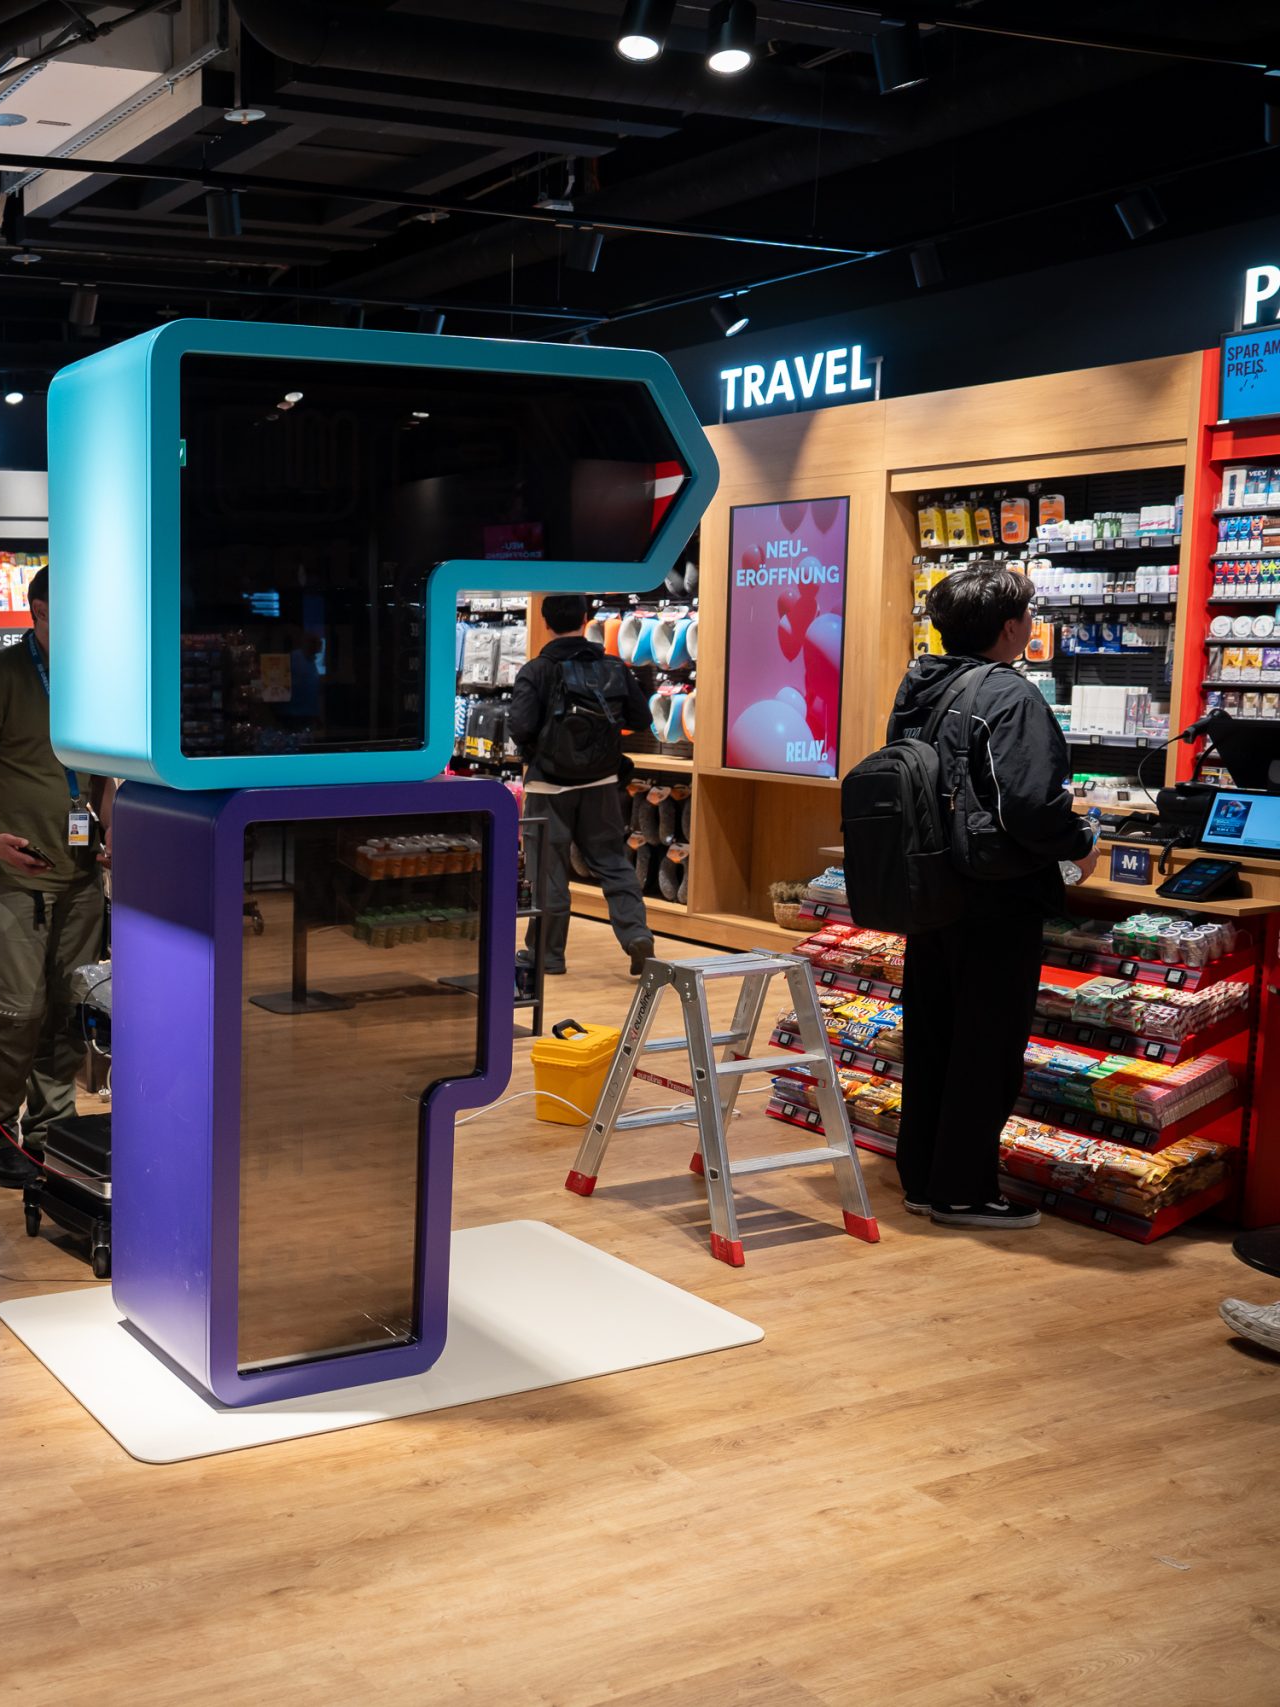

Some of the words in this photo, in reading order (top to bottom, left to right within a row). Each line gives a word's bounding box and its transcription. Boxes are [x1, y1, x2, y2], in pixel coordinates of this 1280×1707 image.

[1243, 264, 1280, 326] P
[1227, 344, 1260, 361] SPAR
[720, 345, 872, 411] TRAVEL
[766, 540, 808, 559] NEU-
[736, 564, 840, 587] ERÖFFNUNG
